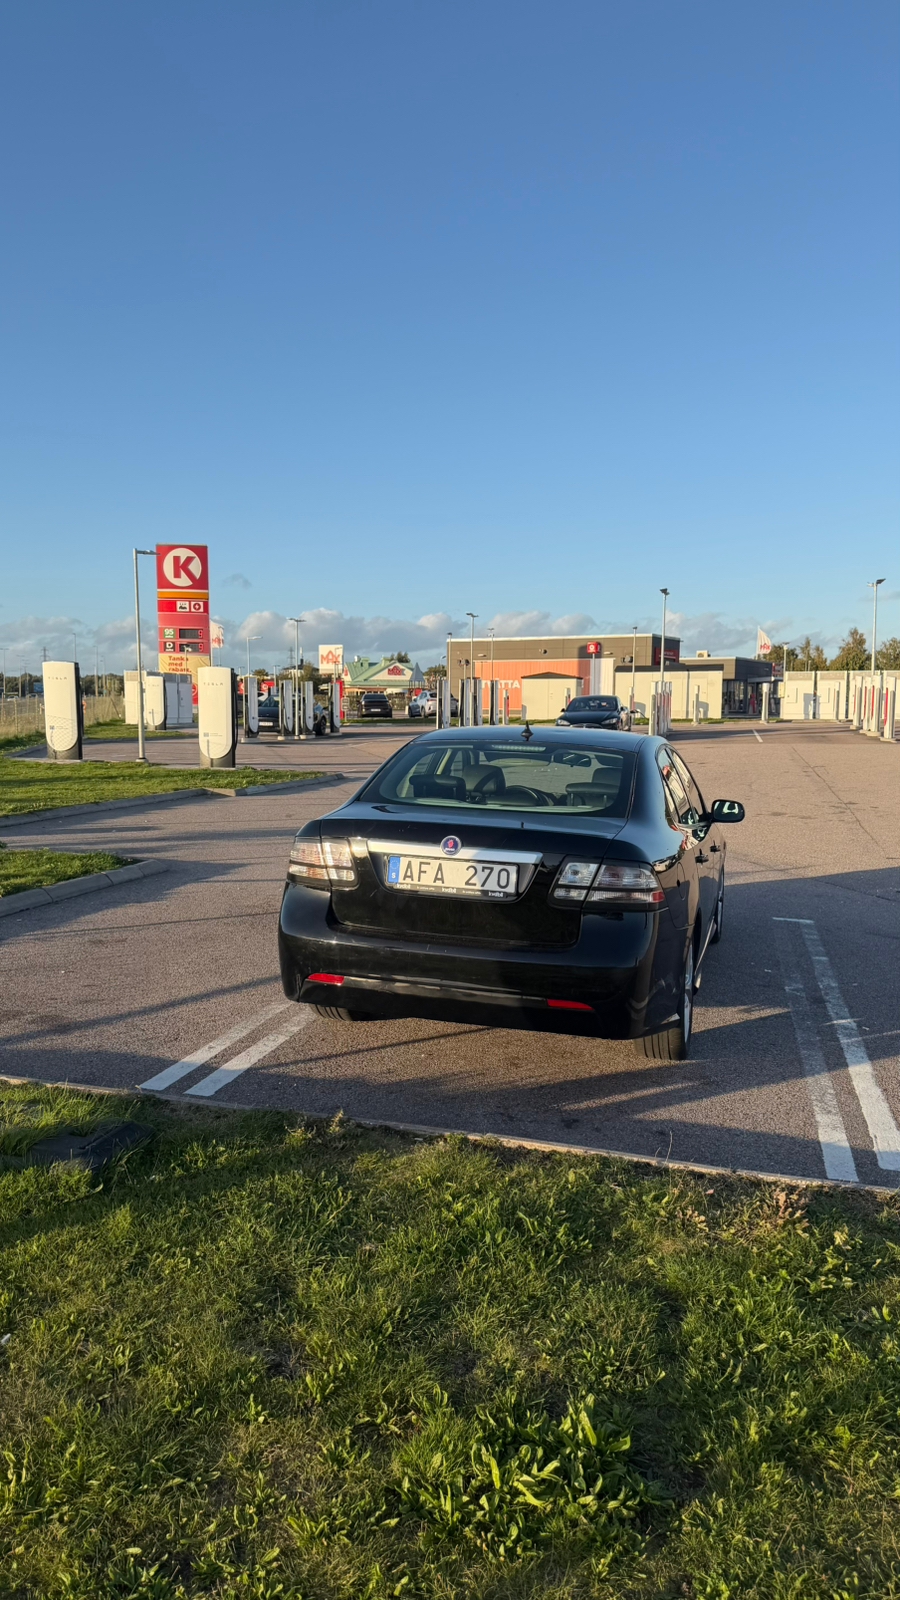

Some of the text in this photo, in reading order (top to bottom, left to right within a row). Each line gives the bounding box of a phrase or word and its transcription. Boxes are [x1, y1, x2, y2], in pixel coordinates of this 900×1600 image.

[173, 556, 198, 584] K
[320, 650, 340, 665] MAX
[402, 860, 511, 889] AFA 270
